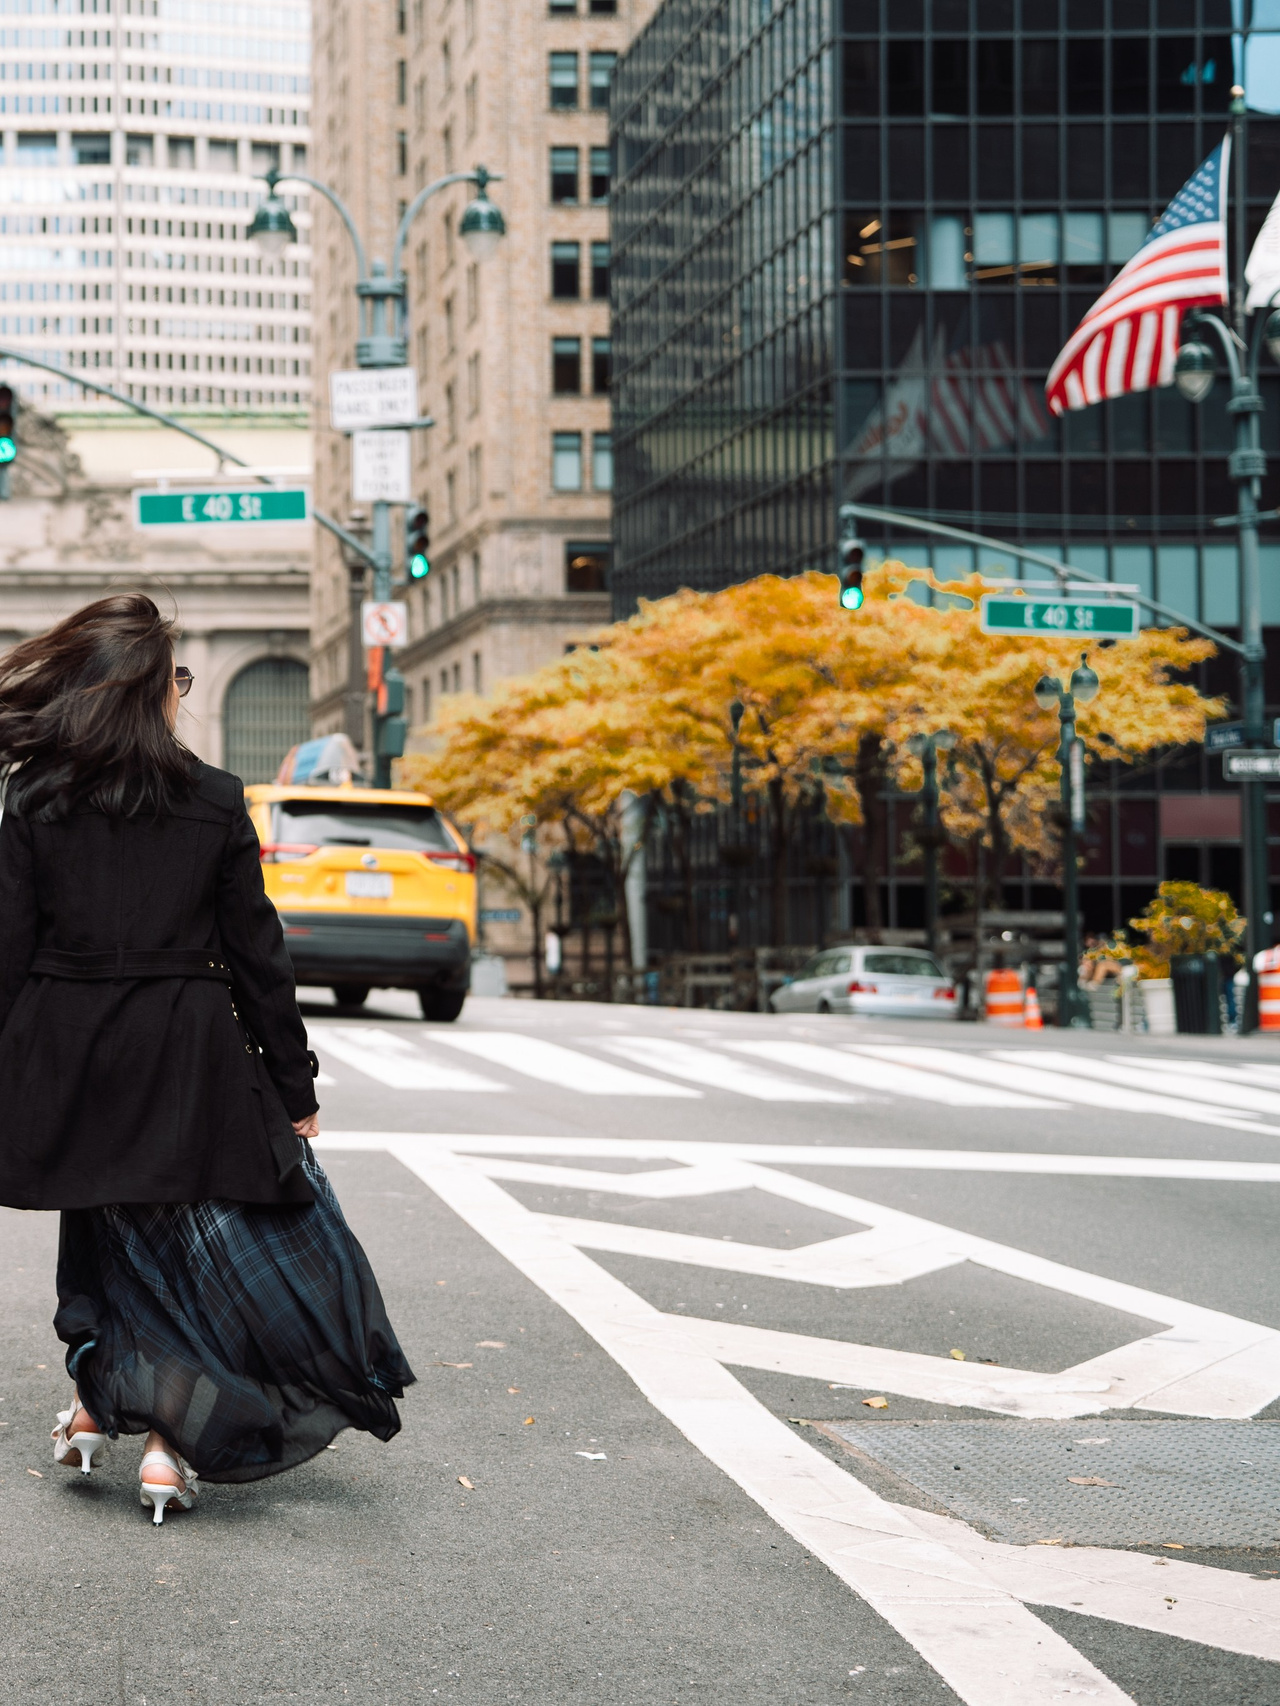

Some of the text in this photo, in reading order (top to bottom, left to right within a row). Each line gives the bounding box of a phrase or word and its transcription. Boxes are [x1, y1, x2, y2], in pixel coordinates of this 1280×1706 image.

[181, 493, 263, 522] E 40 St
[1023, 603, 1095, 631] E 40 St
